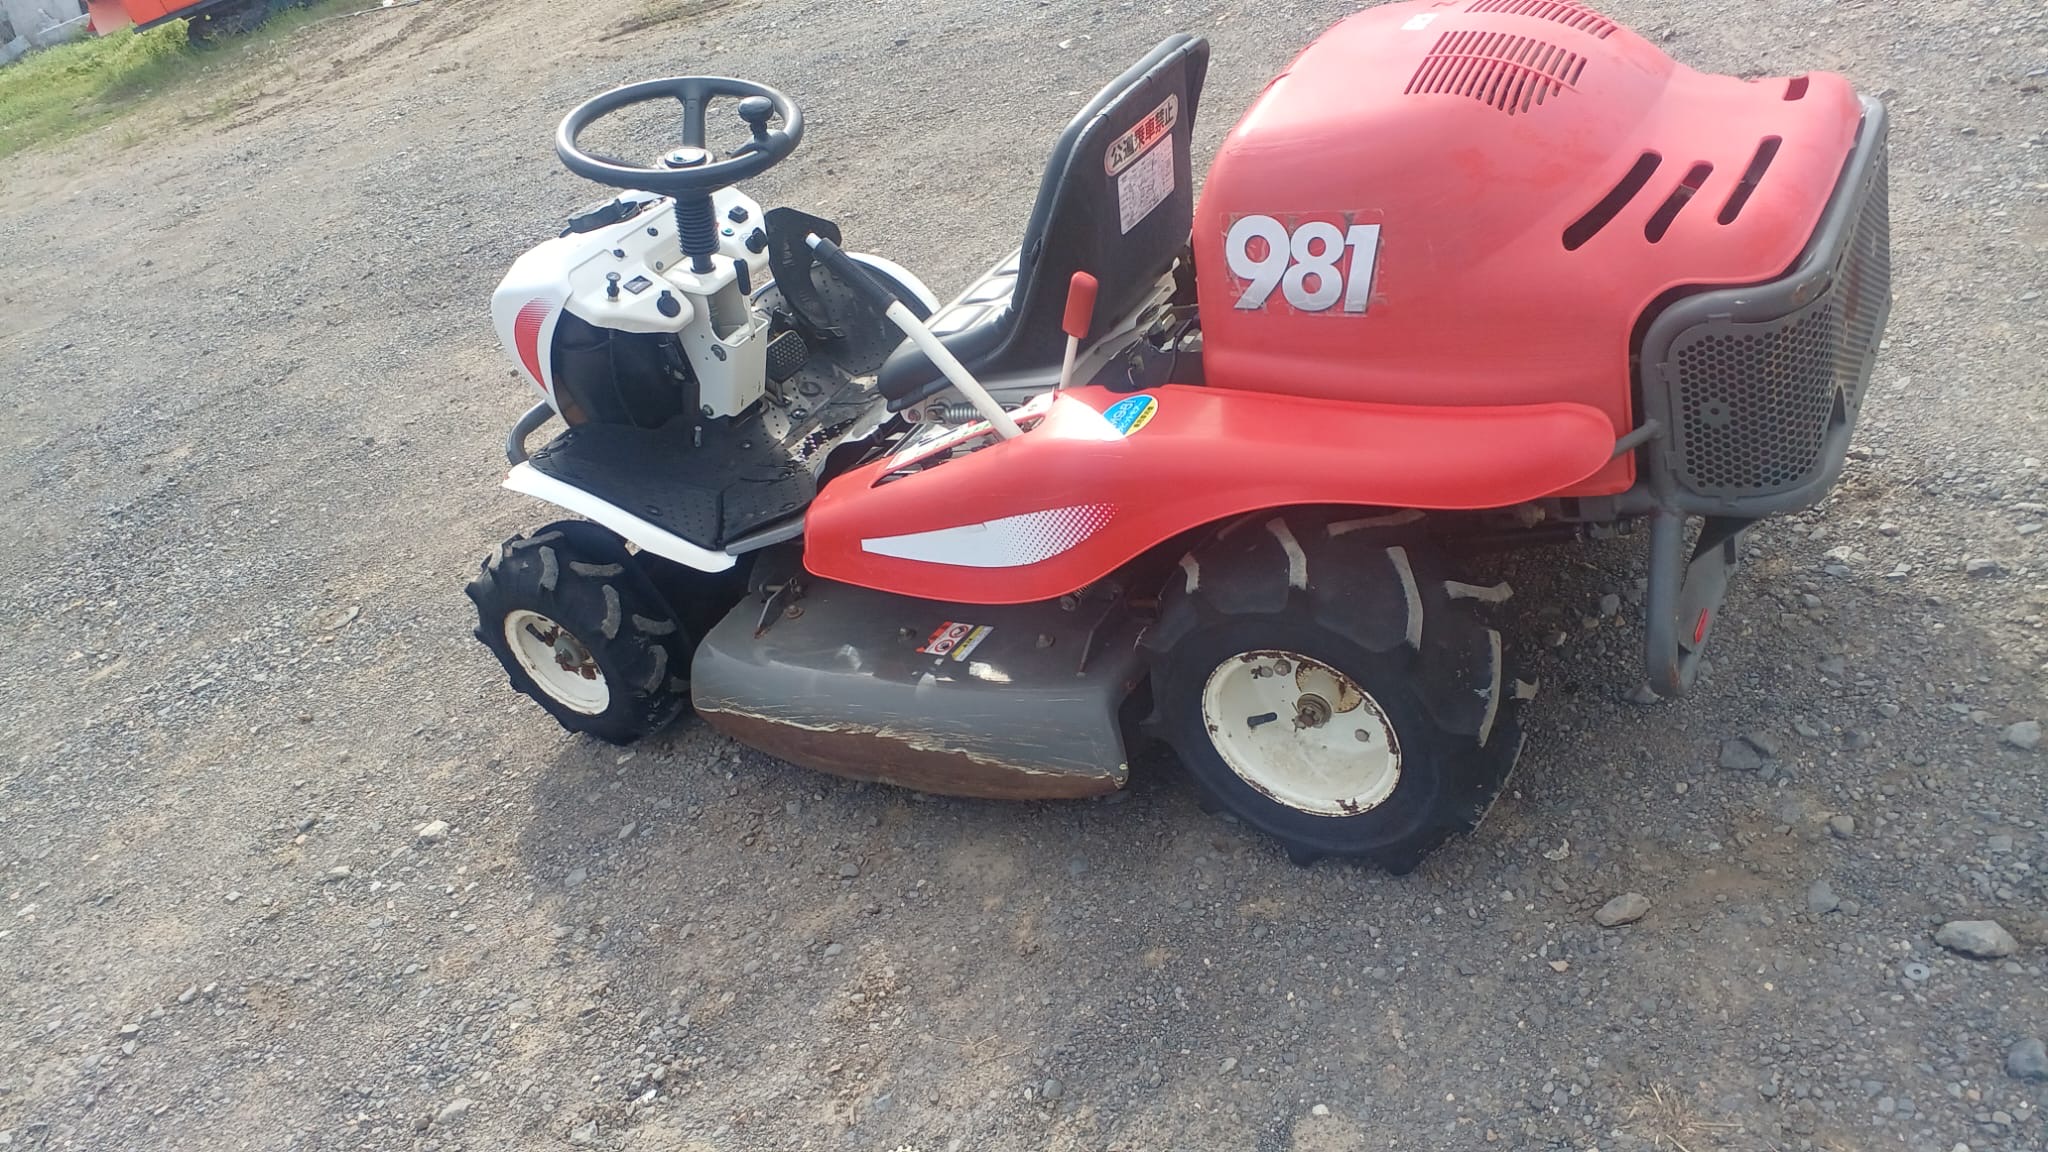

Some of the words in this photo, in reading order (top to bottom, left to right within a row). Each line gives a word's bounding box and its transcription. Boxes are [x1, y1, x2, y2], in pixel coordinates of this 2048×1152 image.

[1111, 102, 1174, 167] 公道乗車禁止
[1226, 214, 1381, 313] 981
